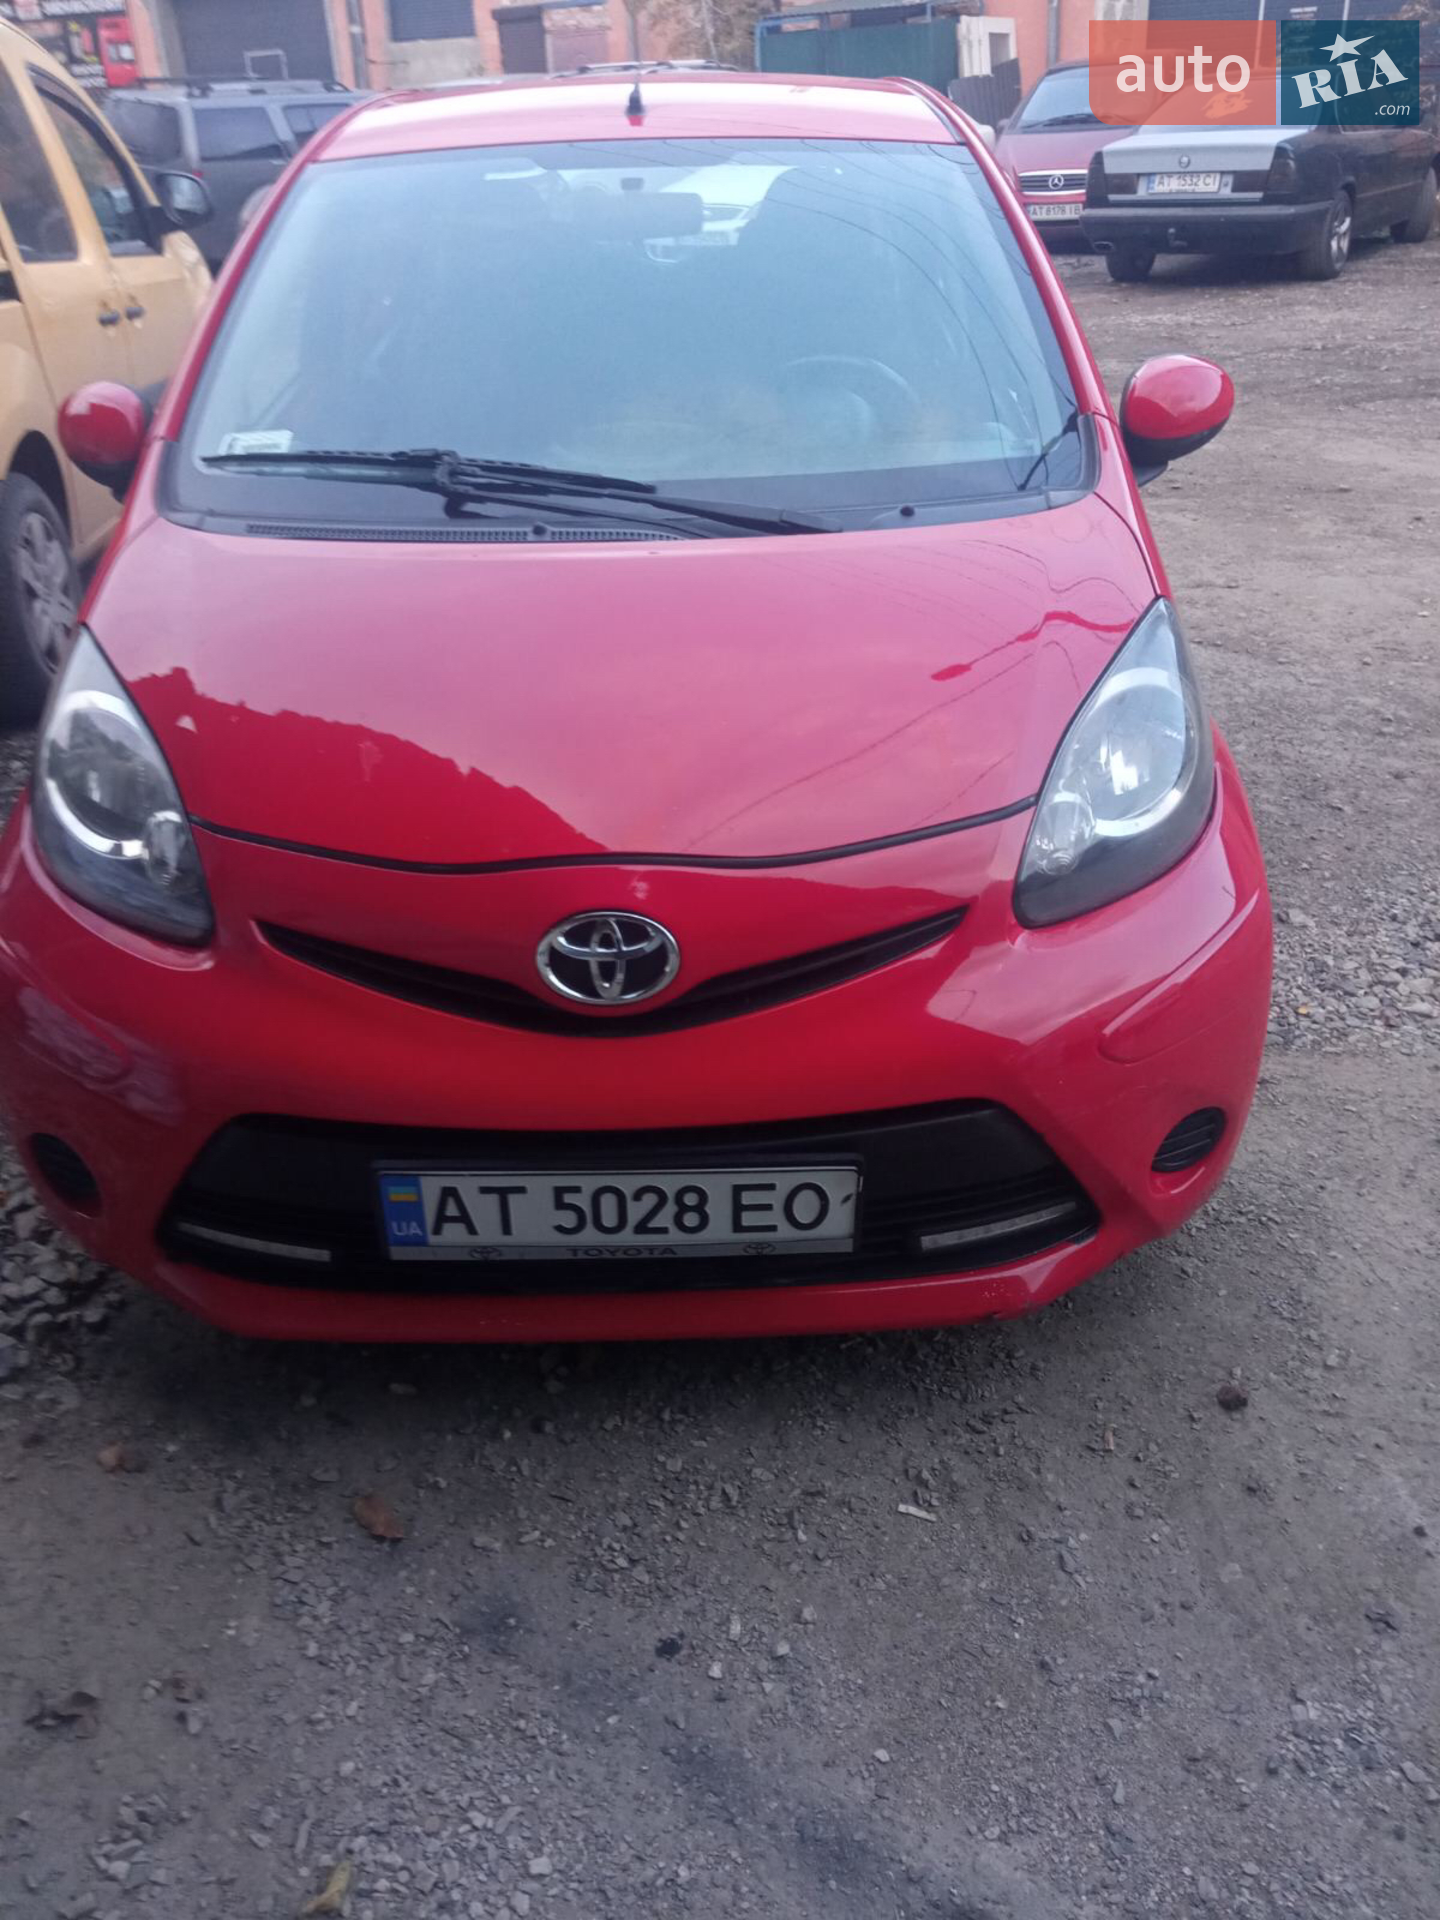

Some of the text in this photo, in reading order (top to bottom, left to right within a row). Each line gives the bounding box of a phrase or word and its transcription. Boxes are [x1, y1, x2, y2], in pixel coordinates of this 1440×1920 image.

[1157, 174, 1173, 187] AT
[431, 1182, 830, 1236] AT 5028 EO
[392, 1221, 424, 1236] UA
[566, 1247, 678, 1258] TOYOTA
